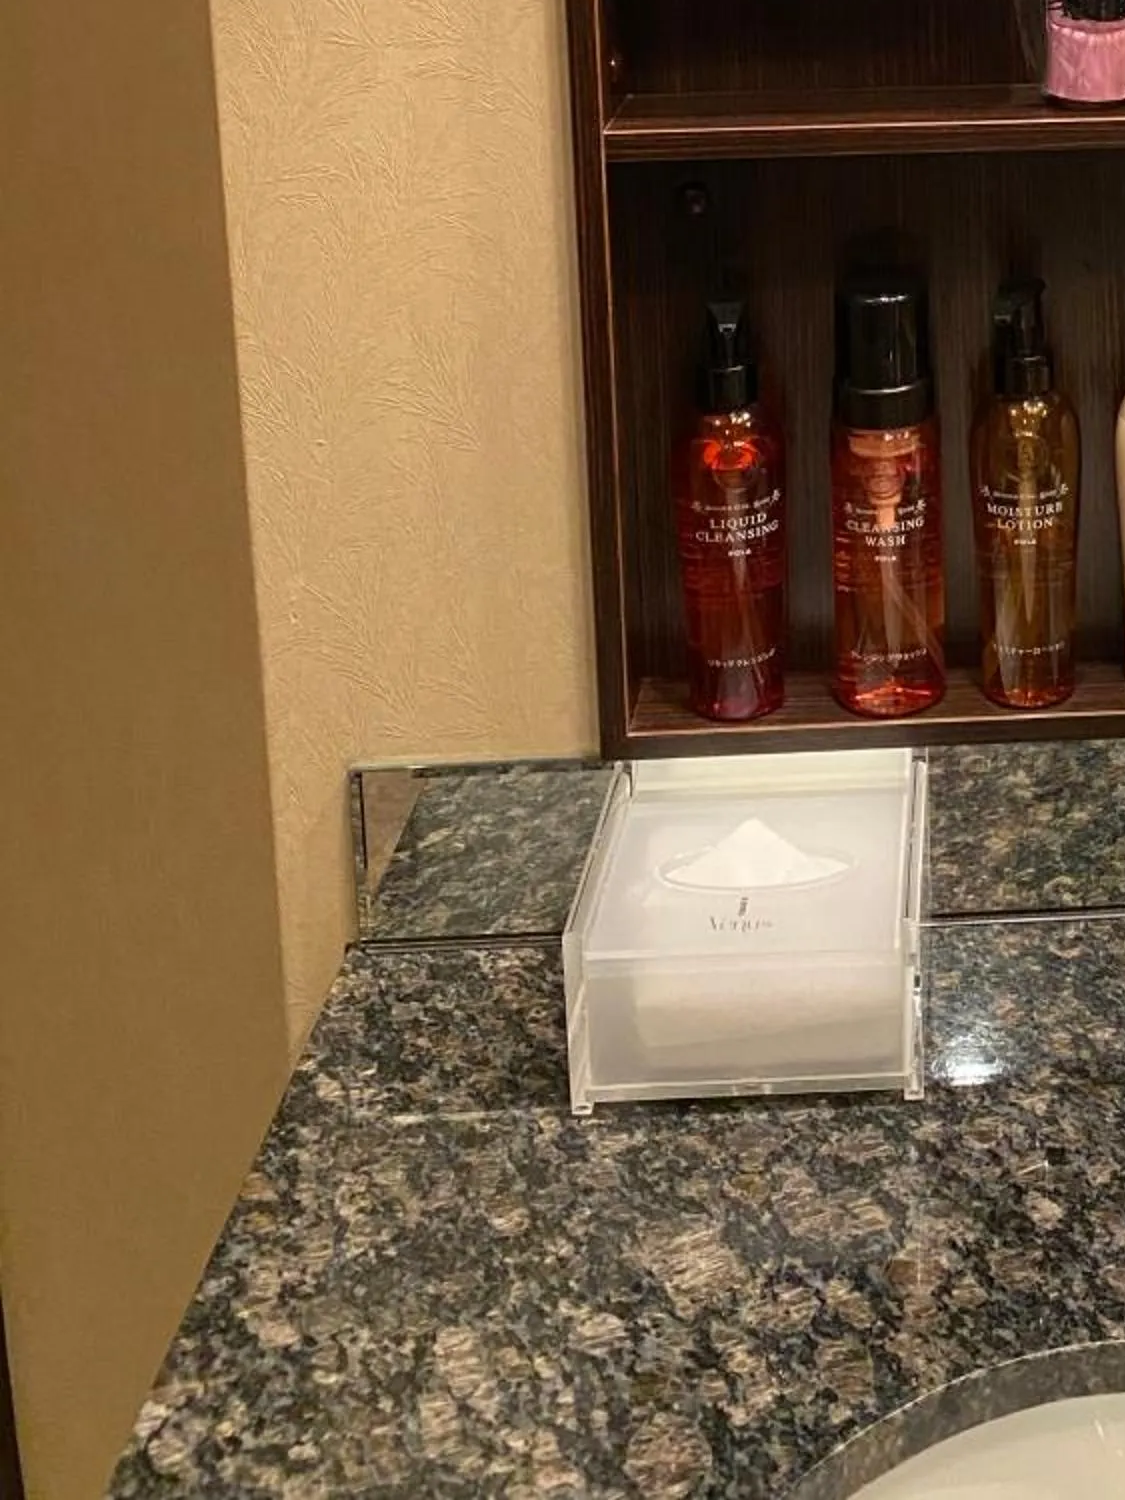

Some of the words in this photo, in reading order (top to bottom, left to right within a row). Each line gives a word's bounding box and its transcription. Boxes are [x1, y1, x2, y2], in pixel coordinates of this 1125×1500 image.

[987, 501, 1063, 517] MOISTURE
[710, 511, 767, 531] LIQUID
[846, 515, 925, 533] CLEANSING
[997, 518, 1054, 532] LOTION
[695, 519, 779, 543] CLEANSING
[865, 534, 906, 547] WASH
